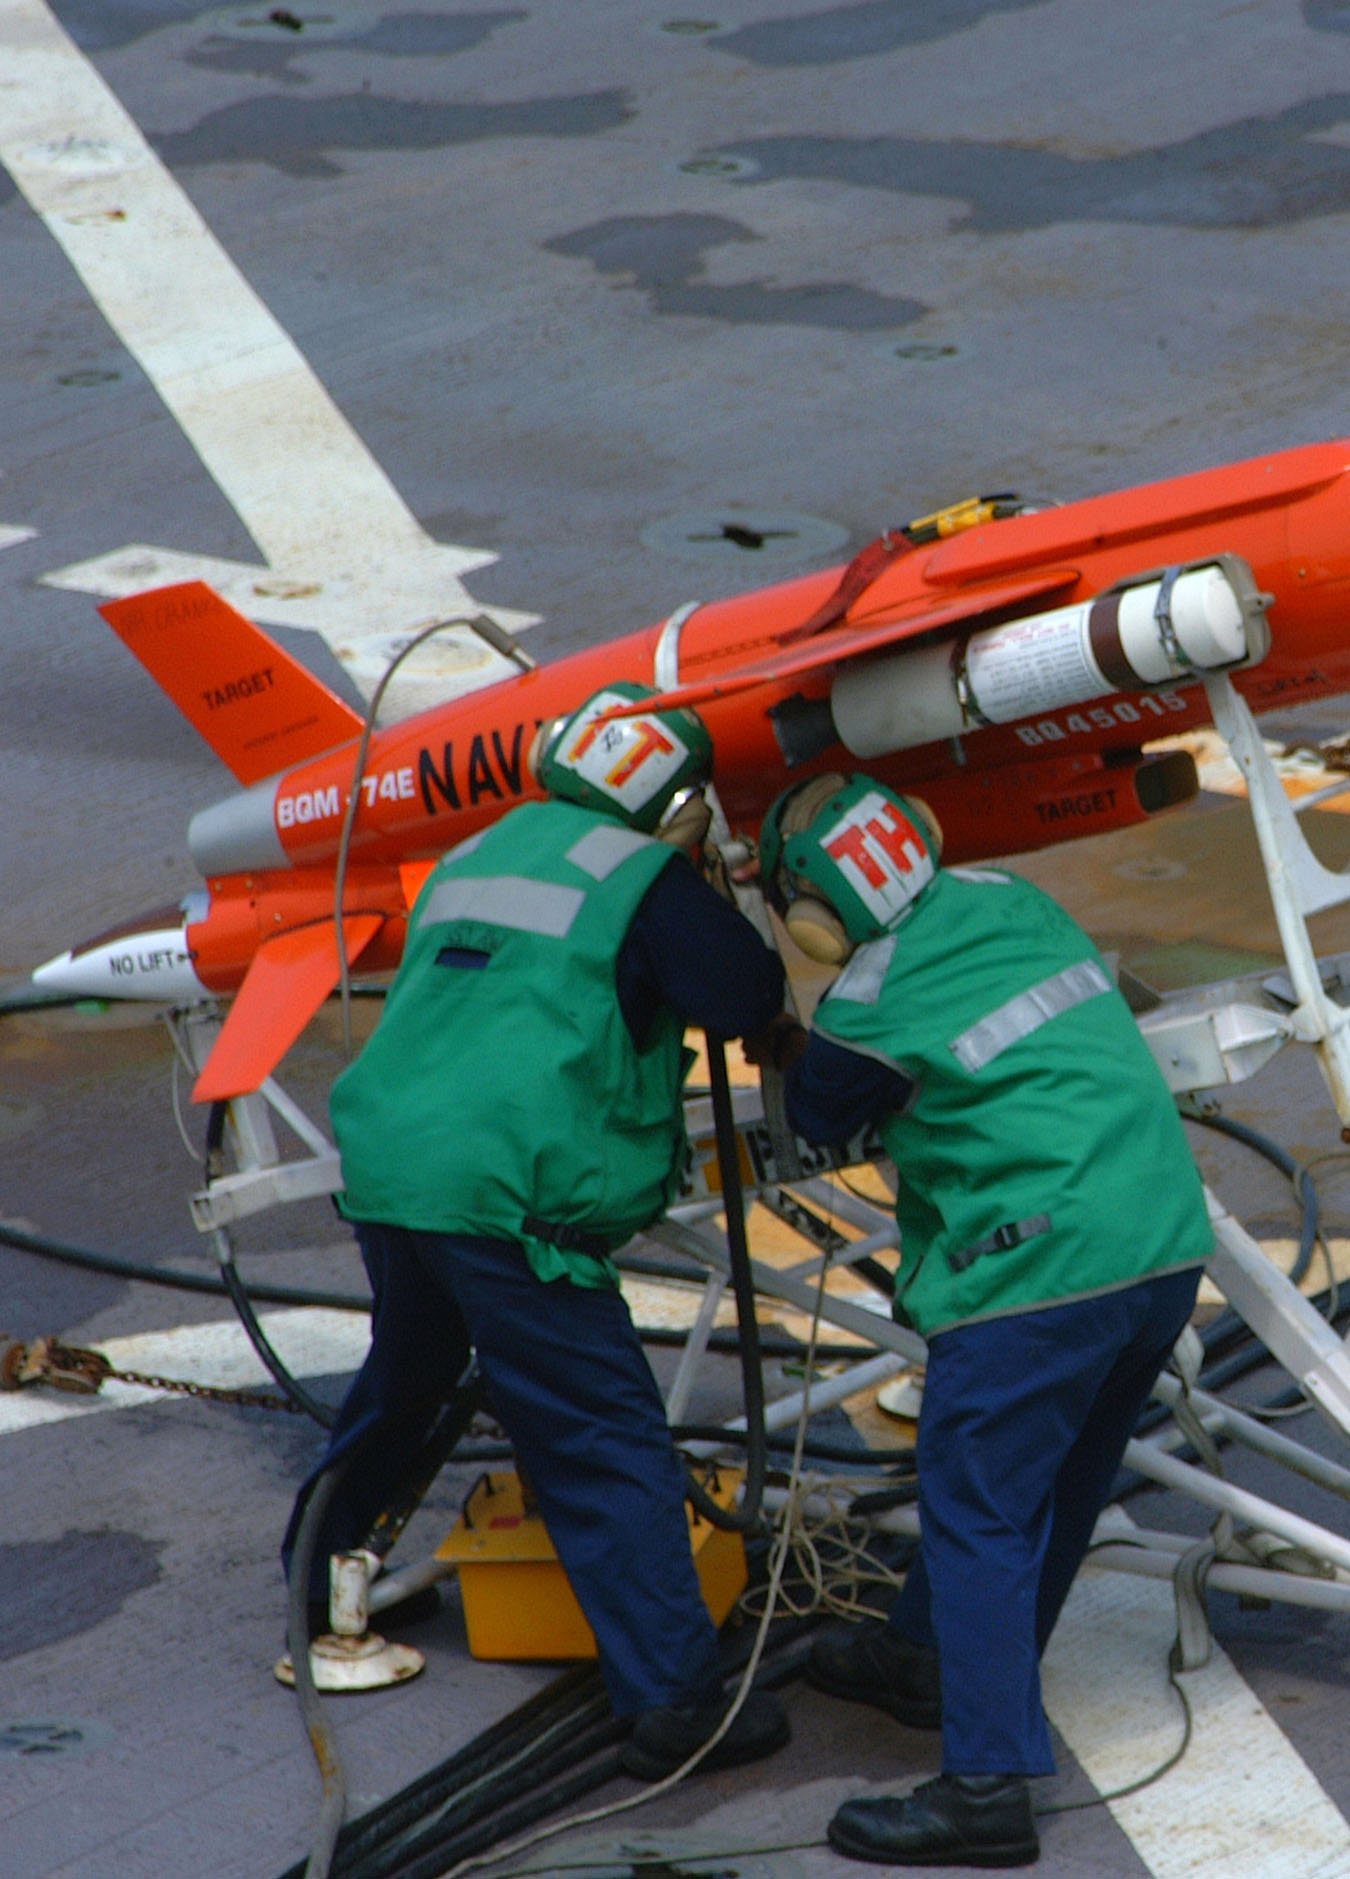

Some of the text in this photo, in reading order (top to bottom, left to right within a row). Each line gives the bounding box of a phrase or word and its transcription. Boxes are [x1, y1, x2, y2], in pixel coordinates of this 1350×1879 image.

[203, 668, 275, 711] TARGET
[418, 717, 547, 820] NAV
[1036, 789, 1116, 823] TARGET
[826, 801, 928, 892] TH
[110, 950, 174, 976] NO LIFT
